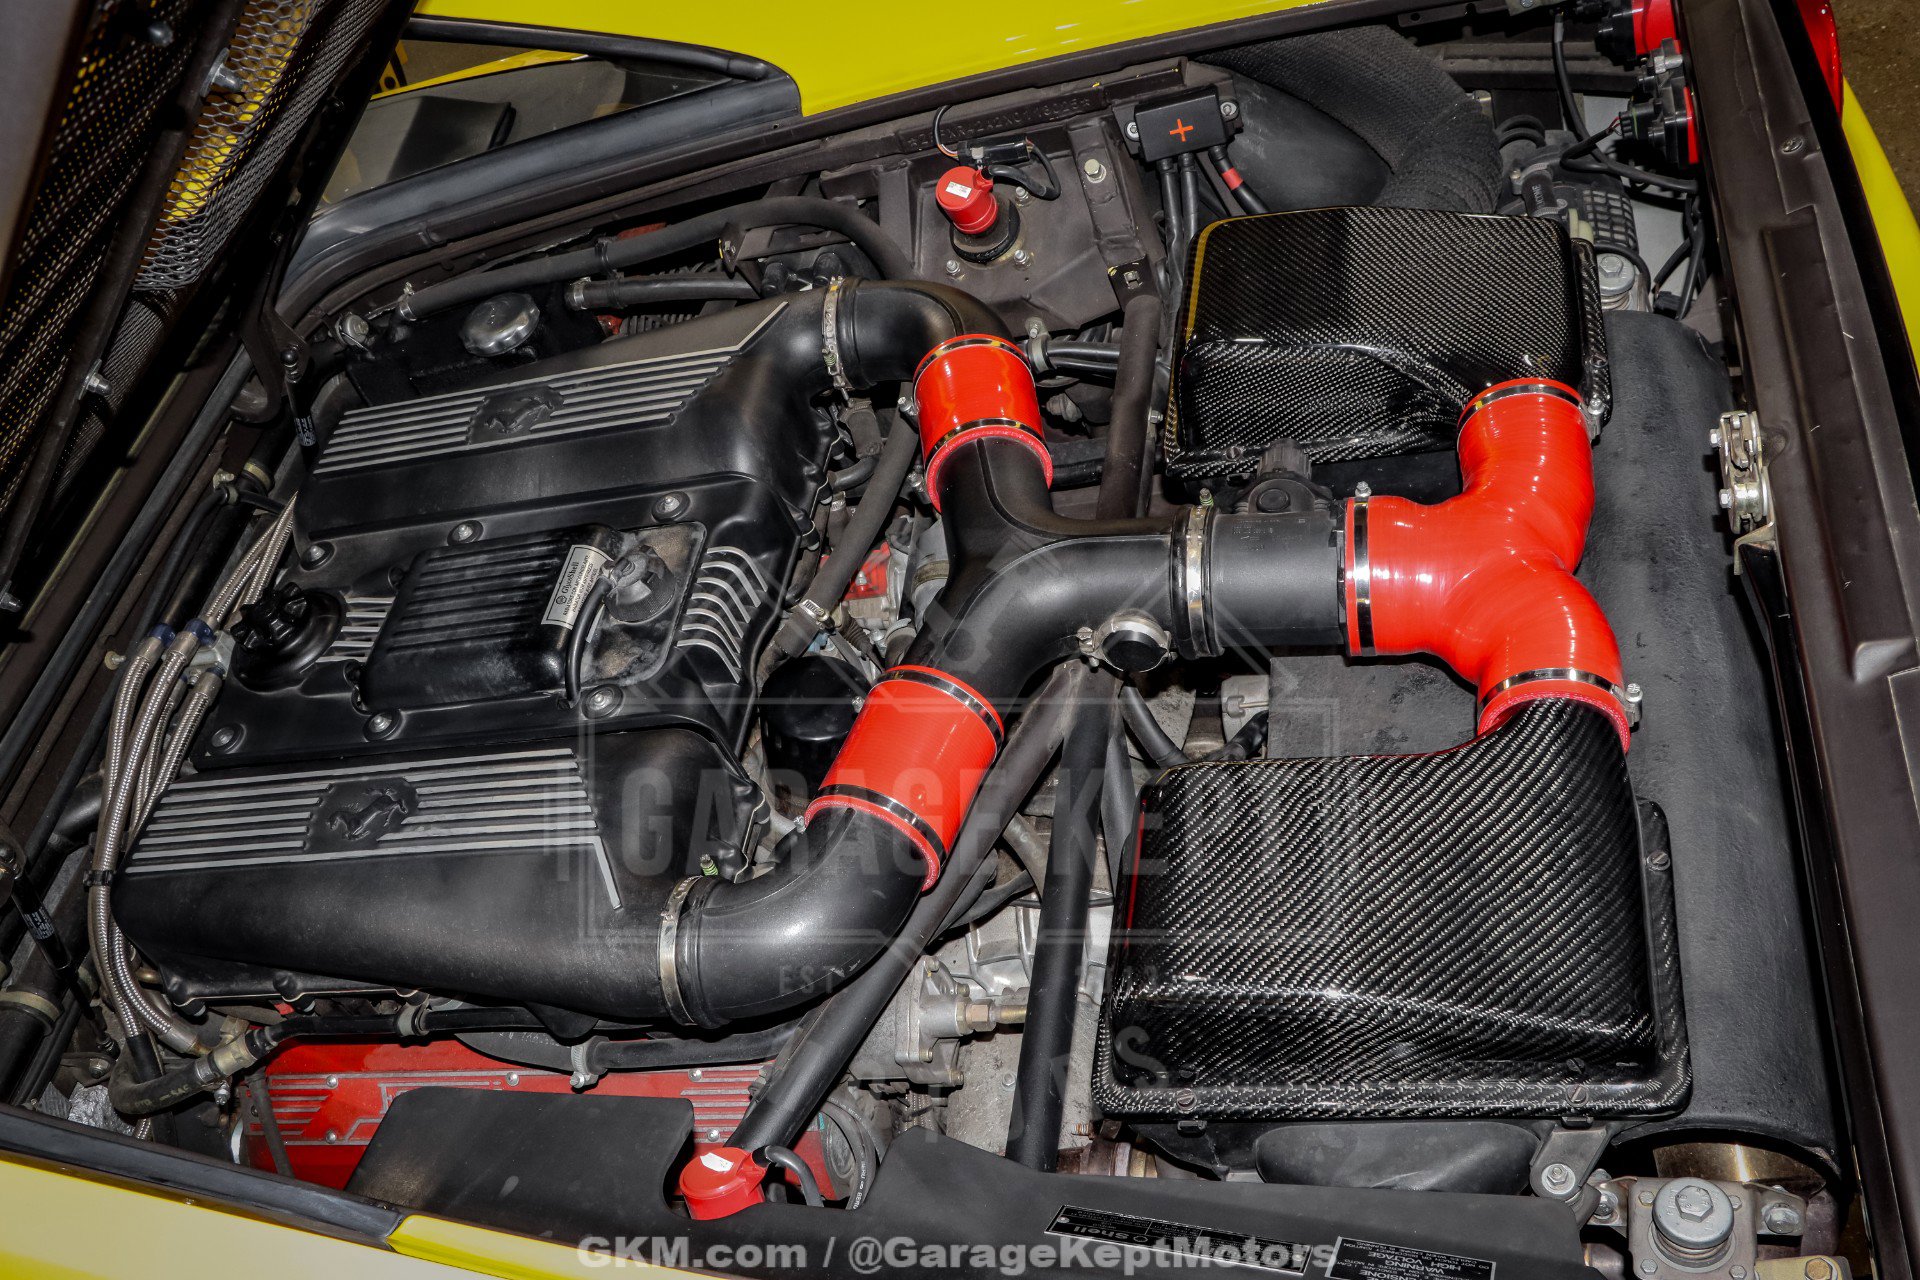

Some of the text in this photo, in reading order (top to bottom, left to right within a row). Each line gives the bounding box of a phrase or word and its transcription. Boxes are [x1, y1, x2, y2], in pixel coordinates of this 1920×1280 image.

[1073, 1226, 1130, 1240] Shell
[1368, 1250, 1461, 1271] HIGH VOLTAGE
[1385, 1259, 1444, 1274] WARNING
[1449, 1256, 1477, 1264] CABLES
